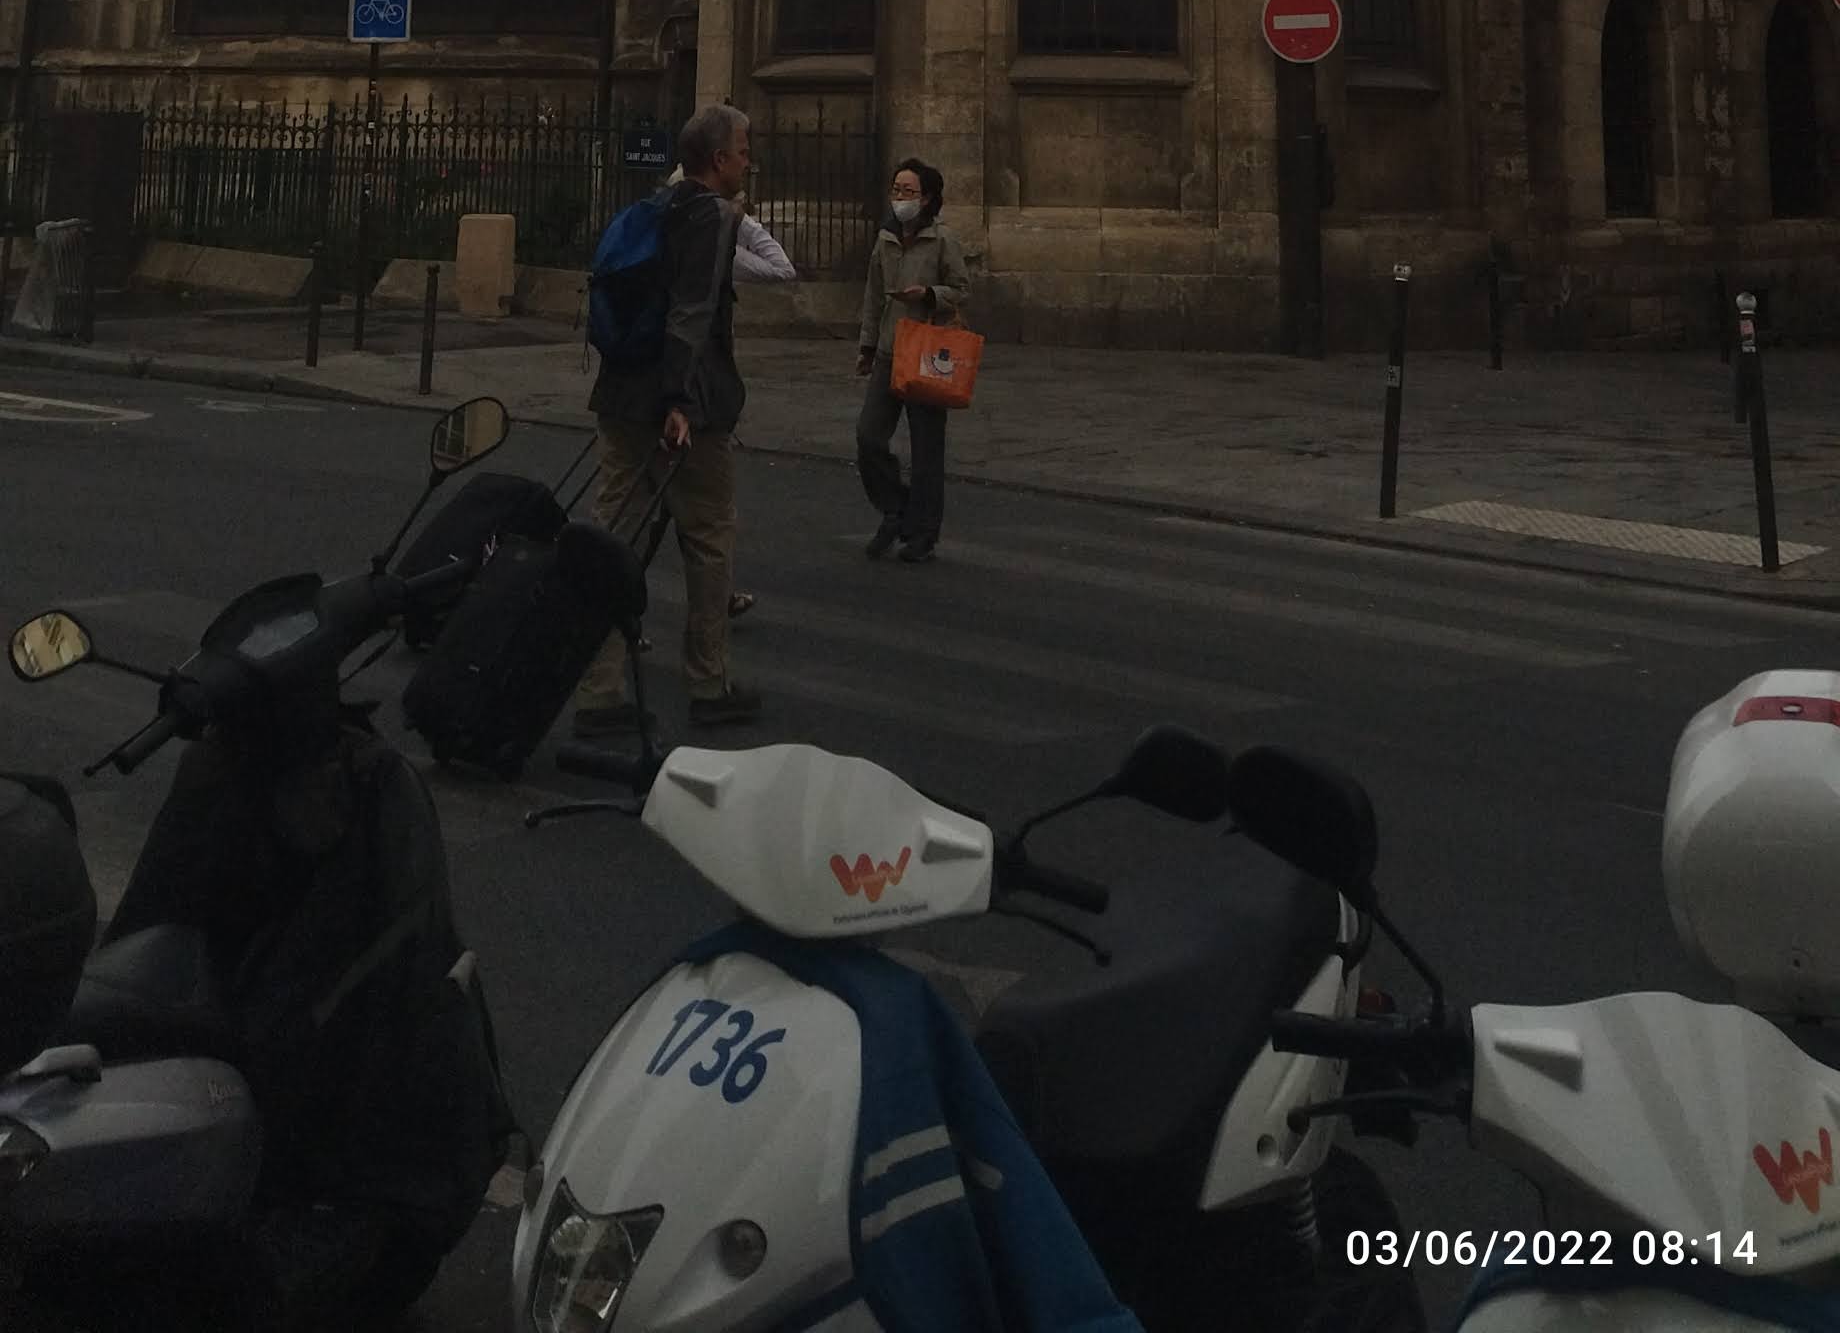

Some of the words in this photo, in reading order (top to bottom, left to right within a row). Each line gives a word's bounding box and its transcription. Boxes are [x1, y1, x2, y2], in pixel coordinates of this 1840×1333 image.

[640, 138, 652, 148] RUE
[625, 151, 640, 162] SAINT
[641, 152, 666, 164] JACQUES
[645, 998, 787, 1104] 1736
